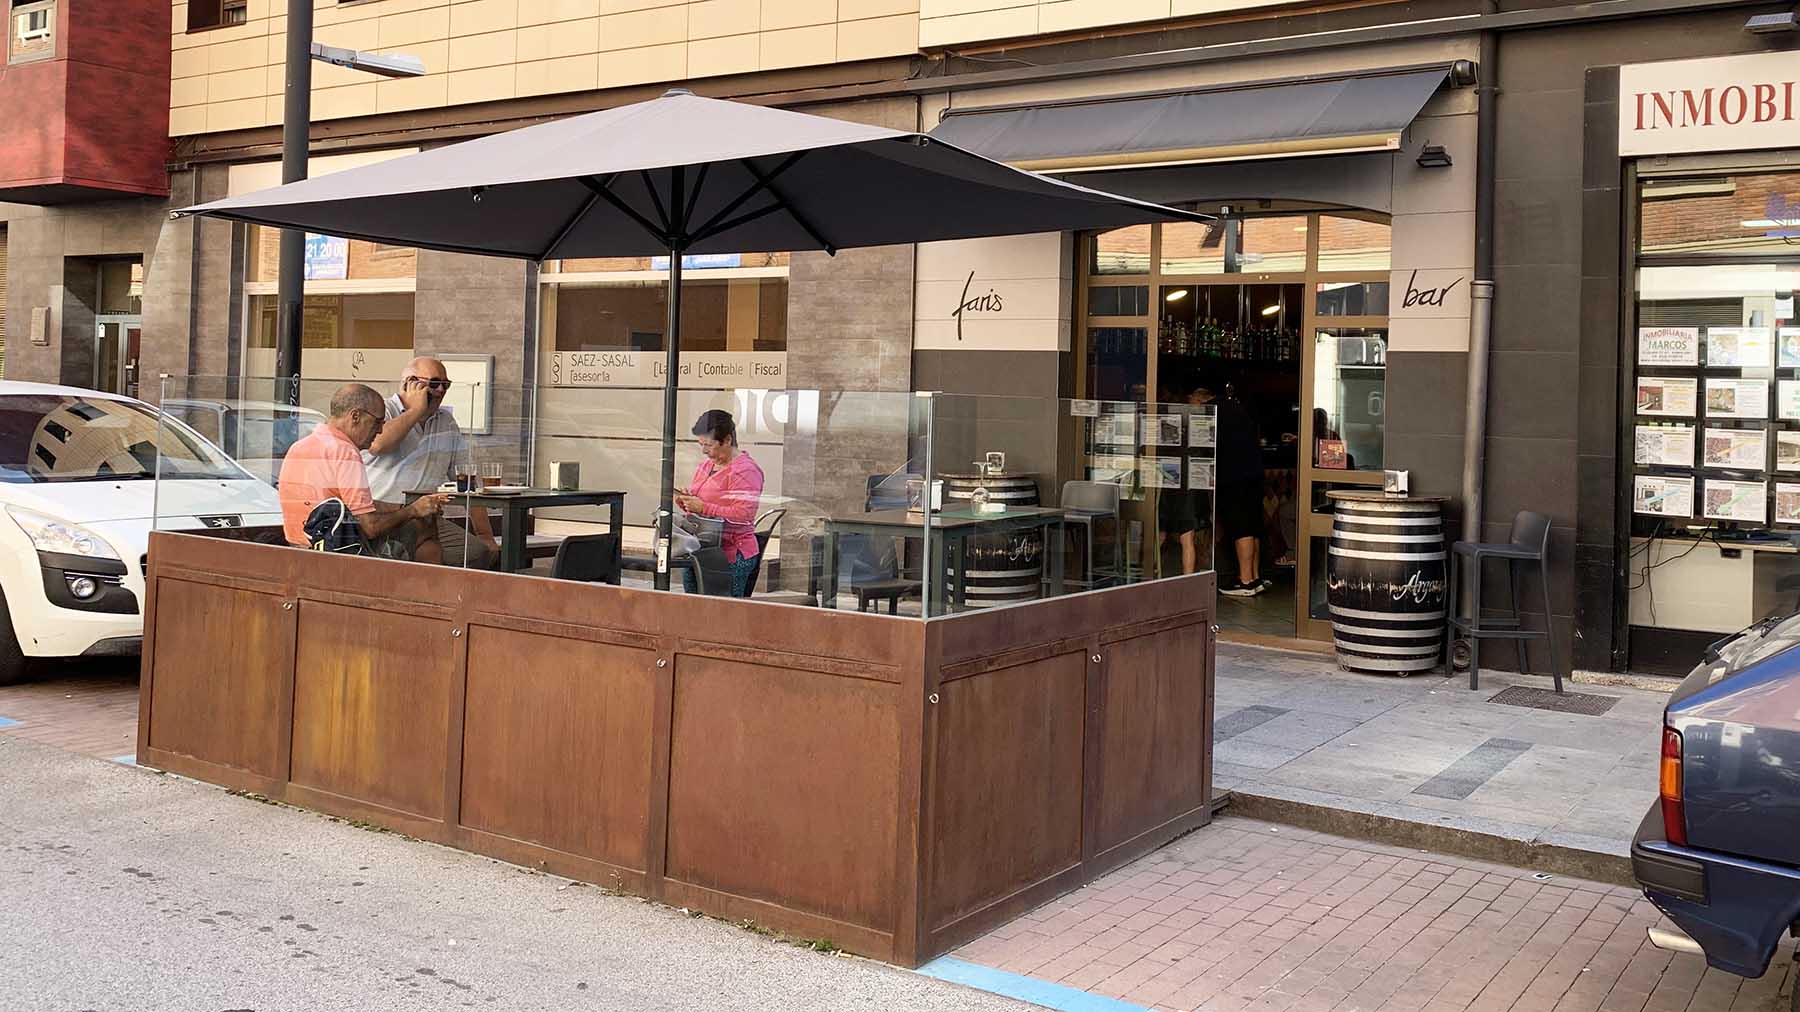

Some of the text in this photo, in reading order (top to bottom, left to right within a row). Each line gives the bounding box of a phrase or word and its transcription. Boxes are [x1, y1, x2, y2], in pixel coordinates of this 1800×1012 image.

[1634, 81, 1800, 131] INMOBI
[1402, 269, 1465, 308] bar
[1648, 340, 1688, 350] MARCOS
[571, 354, 634, 367] SAEZ-SASAL
